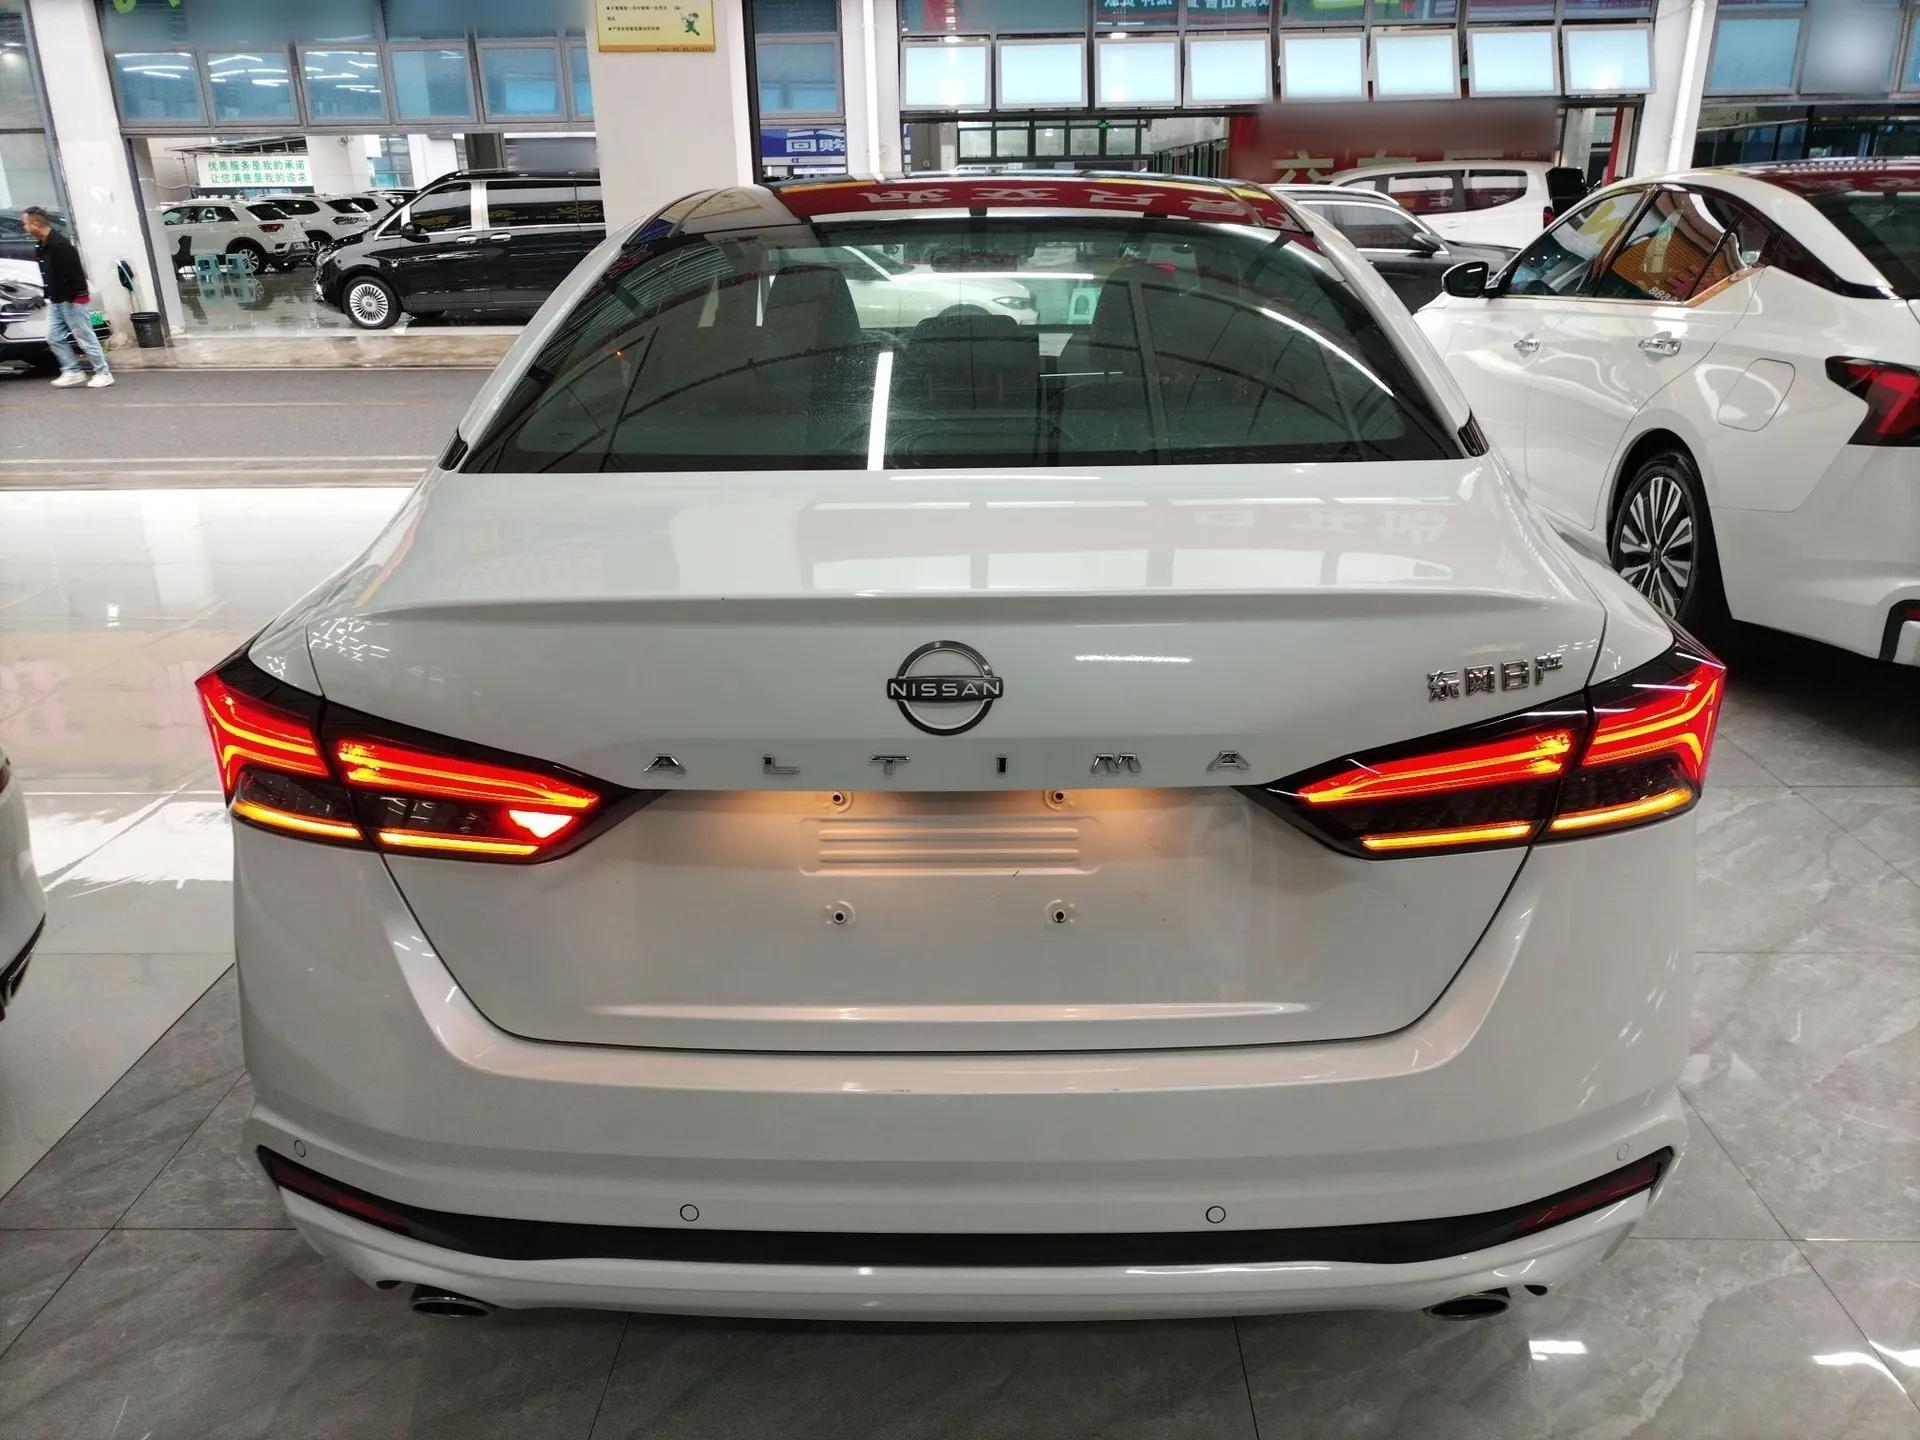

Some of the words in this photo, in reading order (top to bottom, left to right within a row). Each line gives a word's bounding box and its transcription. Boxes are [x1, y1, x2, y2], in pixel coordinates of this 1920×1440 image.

[208, 160, 304, 171] 优质服务是我的承诺
[210, 172, 307, 183] 让您满意是我的追求
[1427, 652, 1563, 702] 东风日产
[890, 682, 1001, 697] NISSAN
[642, 752, 1249, 776] ALTIMA
